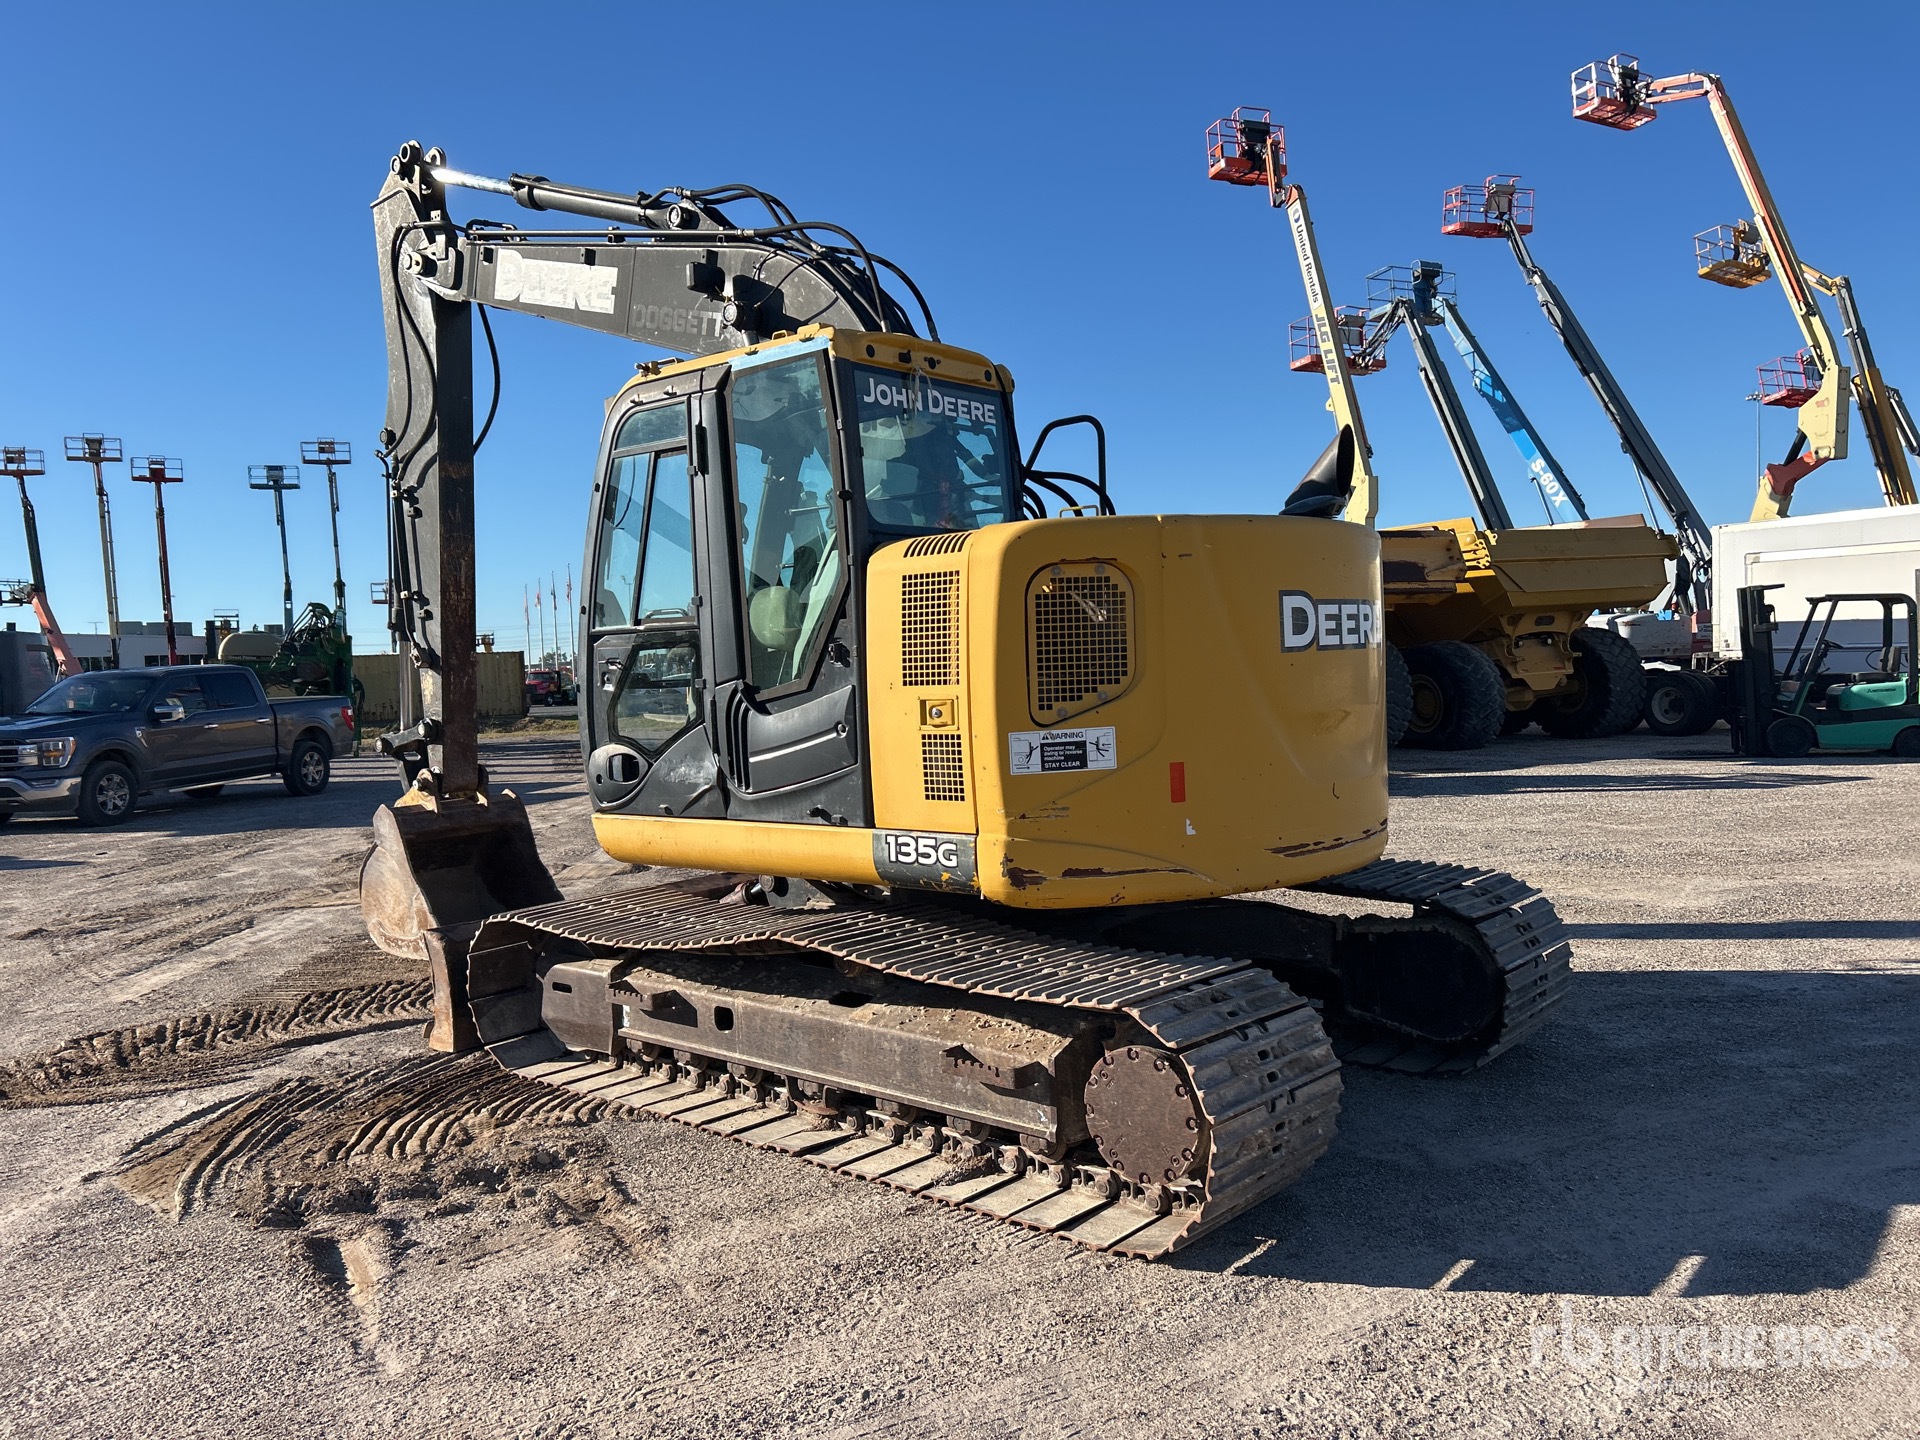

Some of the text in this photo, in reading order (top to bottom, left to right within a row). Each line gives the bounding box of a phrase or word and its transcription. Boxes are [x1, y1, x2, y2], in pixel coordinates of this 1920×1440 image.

[1296, 224, 1319, 304] United Rentals
[631, 303, 723, 337] DOGGETT
[1315, 314, 1341, 385] JLG LIFT
[863, 377, 997, 425] JOHN DEERE
[1531, 458, 1569, 508] S-60X
[1050, 732, 1084, 740] WARNING
[885, 834, 959, 869] 135G
